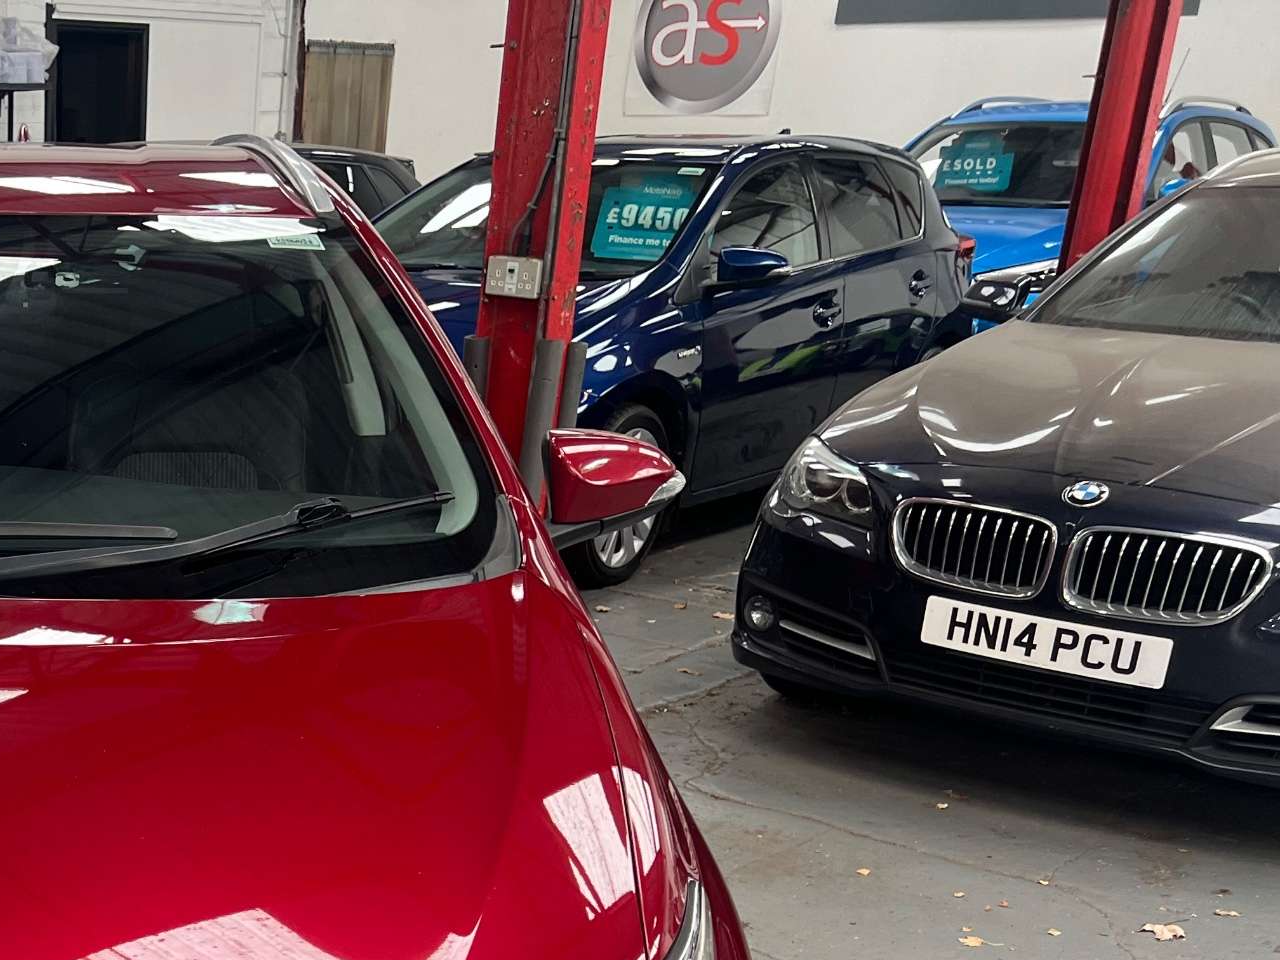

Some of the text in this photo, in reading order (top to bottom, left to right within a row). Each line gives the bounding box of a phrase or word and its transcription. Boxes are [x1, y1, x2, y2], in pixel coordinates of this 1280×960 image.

[652, 0, 741, 66] as
[608, 235, 643, 245] Finance
[645, 238, 659, 246] me
[946, 607, 1142, 676] HN14 PCU
